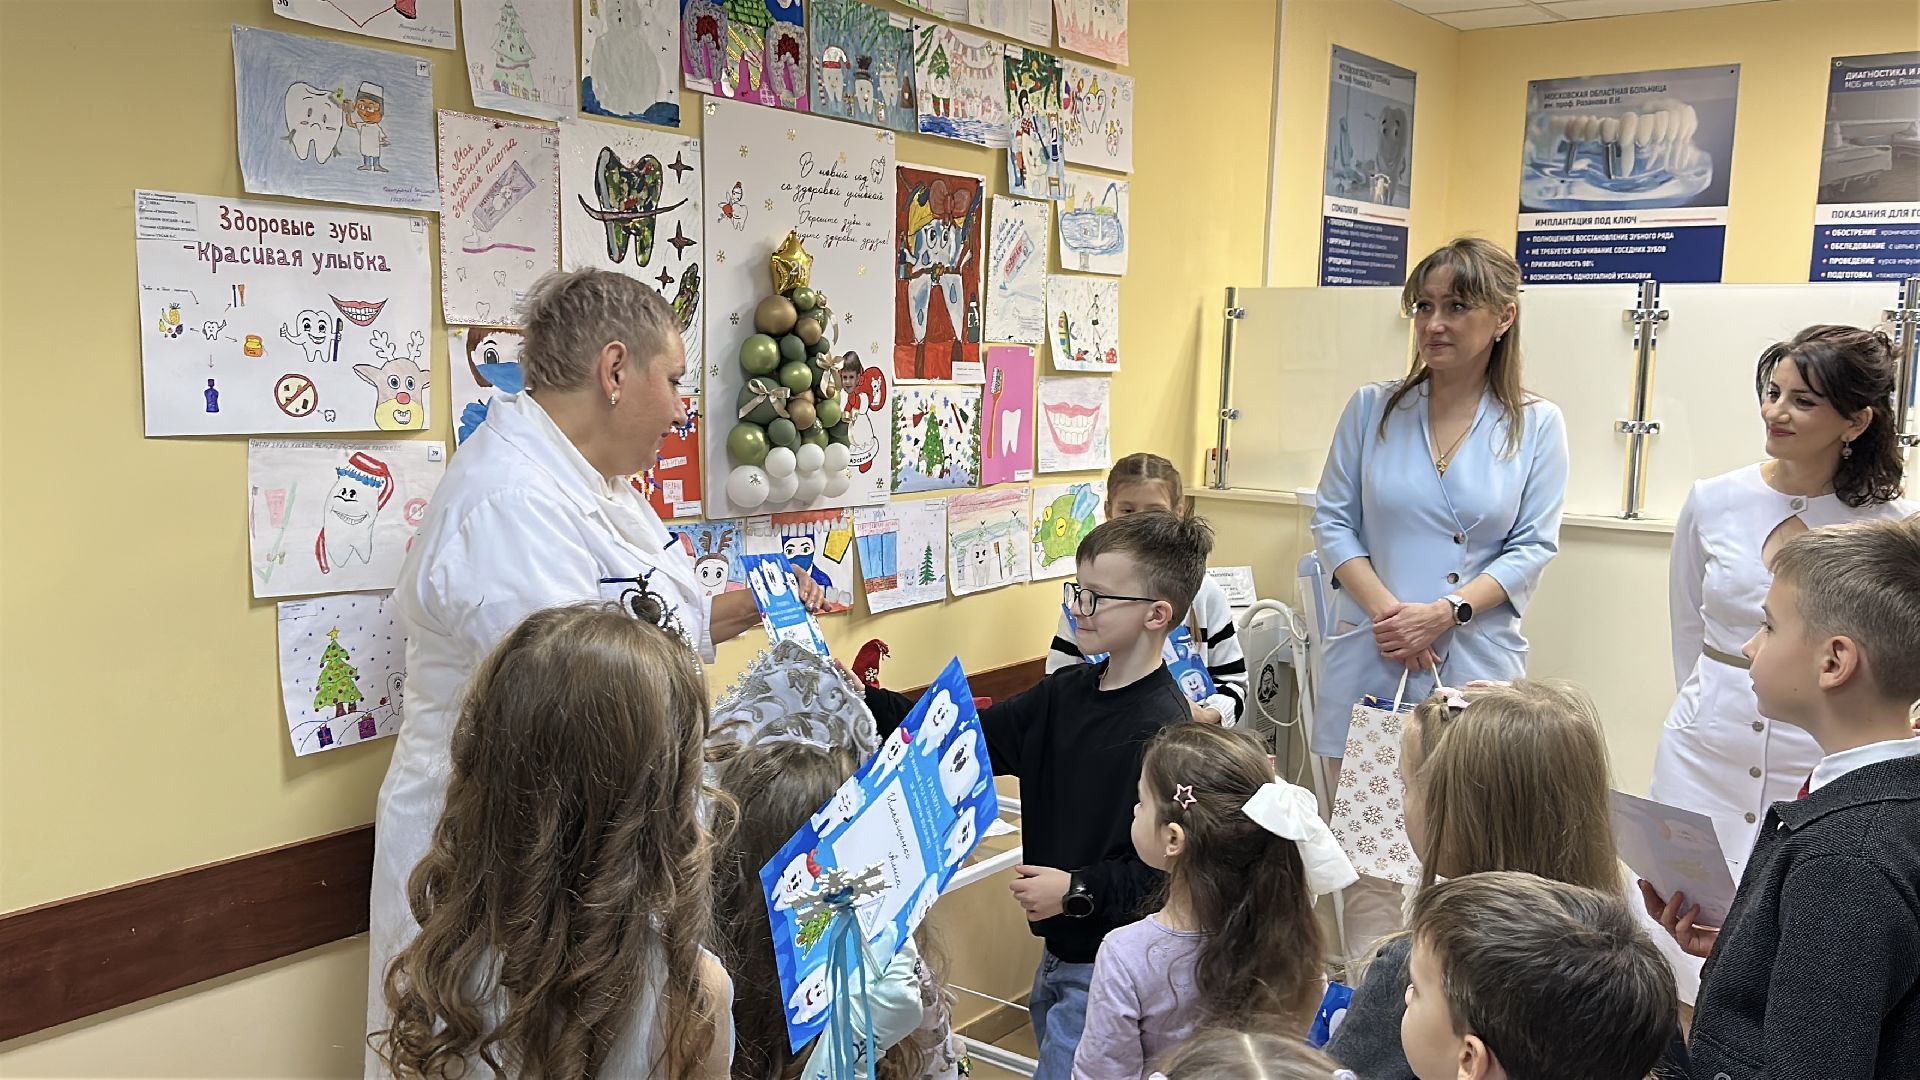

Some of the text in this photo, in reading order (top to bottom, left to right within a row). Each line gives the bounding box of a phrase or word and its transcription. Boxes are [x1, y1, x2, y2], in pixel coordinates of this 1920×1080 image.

[1845, 68, 1907, 80] ДИАГНОСТИКА
[1908, 67, 1916, 76] И
[1629, 85, 1667, 95] БОЛЬНИЦА
[799, 151, 814, 178] В
[1831, 209, 1886, 218] ПОКАЗАНИЯ
[1887, 208, 1909, 218] ДЛЯ
[219, 205, 373, 245] Здоровые зубы
[1535, 215, 1637, 227] ИМПЛАНТАЦИЯ ПОД КЛЮЧ
[1532, 232, 1675, 243] ПОЛНОЦЕННОЕ ВОССТАНОВЛЕНИЕ ЗУБНОГО РЯДА
[1831, 229, 1877, 237] ОБОСТРЕНИЕ
[1539, 247, 1572, 255] ТРЕБУЕТСЯ
[1572, 246, 1613, 255] ОБТАЧИВАНИЕ
[1613, 246, 1647, 254] СОСЕДНИХ
[1647, 245, 1667, 253] ЗУБОВ
[1830, 242, 1886, 250] ОБСЛЕДОВАНИЕ
[311, 251, 392, 276] улыбка
[1829, 257, 1876, 265] ПРОВЕДЕНИЕ
[1529, 271, 1652, 281] ВОЗМОЖНОСТЬ ОДНОЭТАПНОЙ УСТАНОВКИ
[1827, 271, 1873, 279] ПОДГОТОВКА
